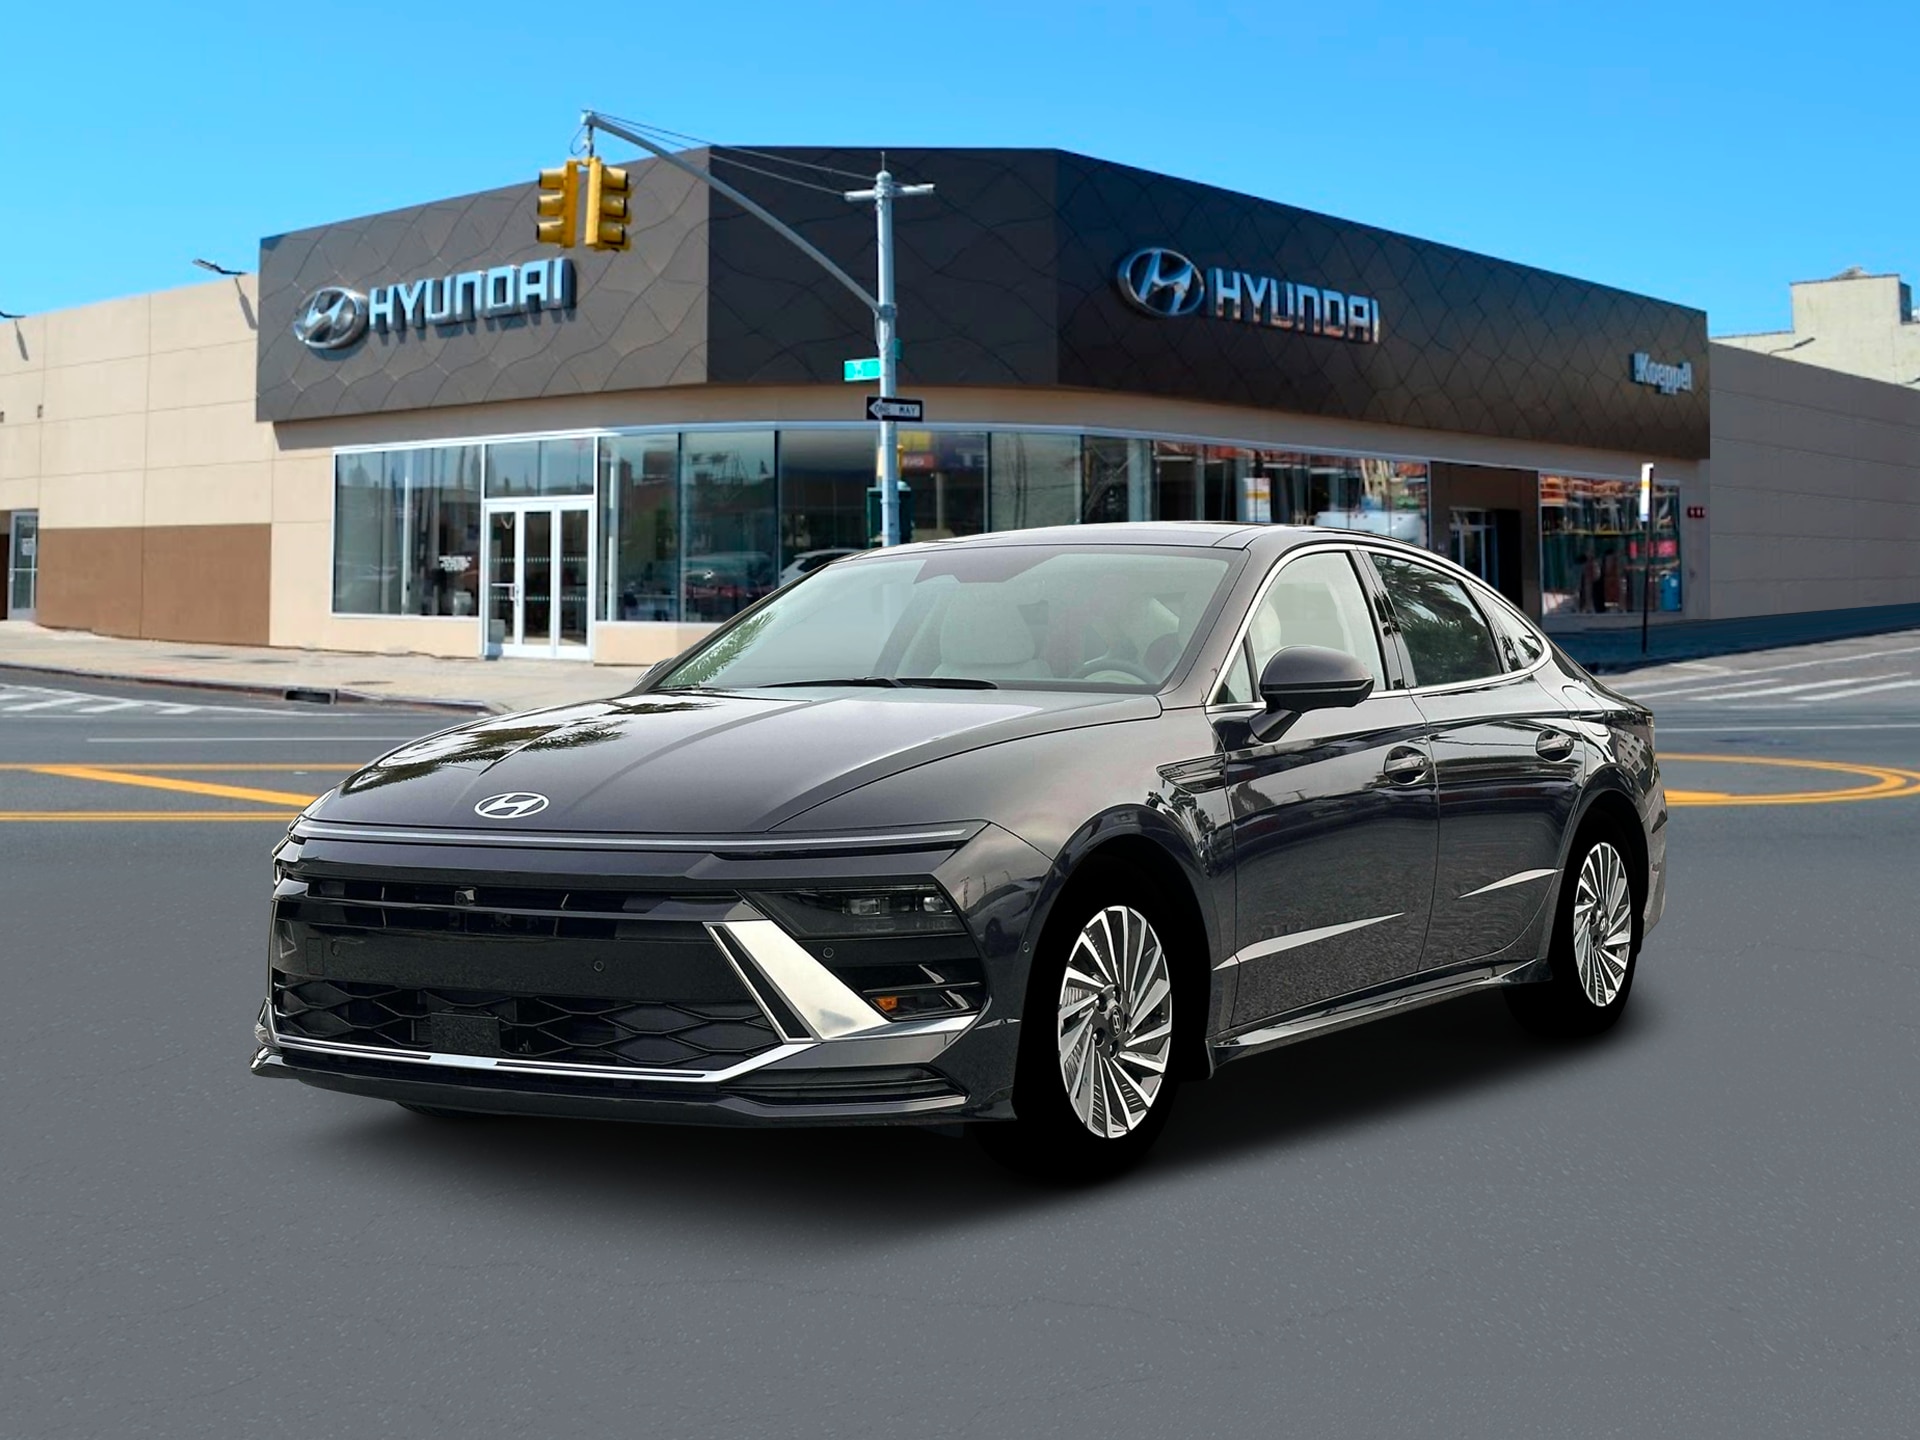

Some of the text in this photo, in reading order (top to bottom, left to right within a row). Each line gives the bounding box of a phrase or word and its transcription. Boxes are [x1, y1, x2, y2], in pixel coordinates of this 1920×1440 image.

[368, 257, 572, 331] HYUNDAI
[1214, 268, 1380, 344] HYUNDAI
[1634, 353, 1692, 395] Koeppel
[899, 406, 916, 415] WAY
